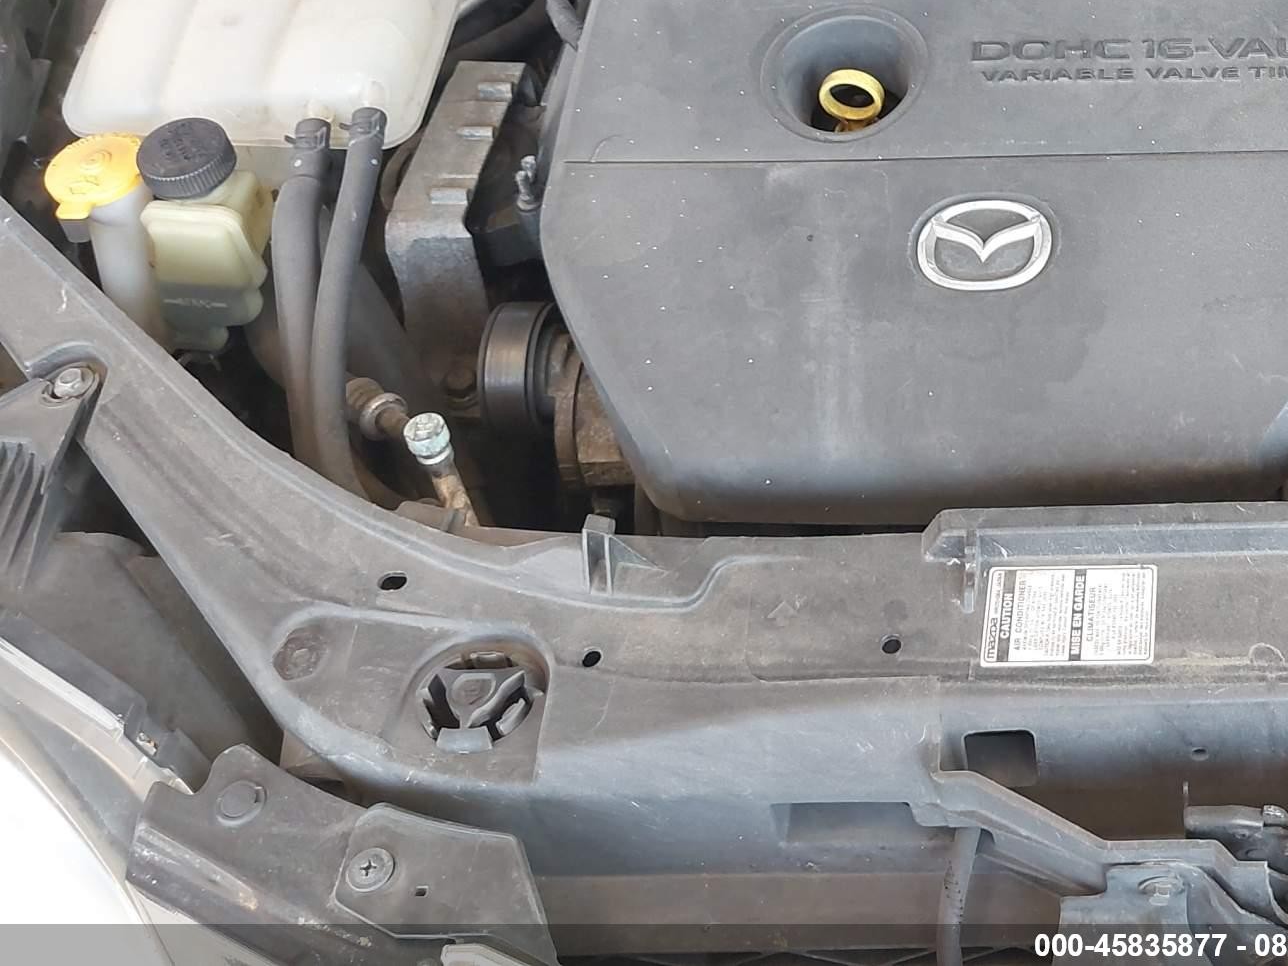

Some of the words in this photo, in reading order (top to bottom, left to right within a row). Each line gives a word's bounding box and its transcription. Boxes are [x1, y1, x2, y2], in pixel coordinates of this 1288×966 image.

[971, 38, 1131, 61] DOHC
[980, 67, 1137, 82] VARIABLE
[1144, 65, 1241, 82] VALVE
[1073, 575, 1086, 611] GARDE
[999, 593, 1014, 639] CAUTION
[1014, 580, 1027, 633] CONDITIONER
[1086, 586, 1097, 642] CLIMATISEUR
[1072, 613, 1083, 628] EN
[1013, 637, 1021, 650] AIR
[1069, 629, 1082, 655] MISE
